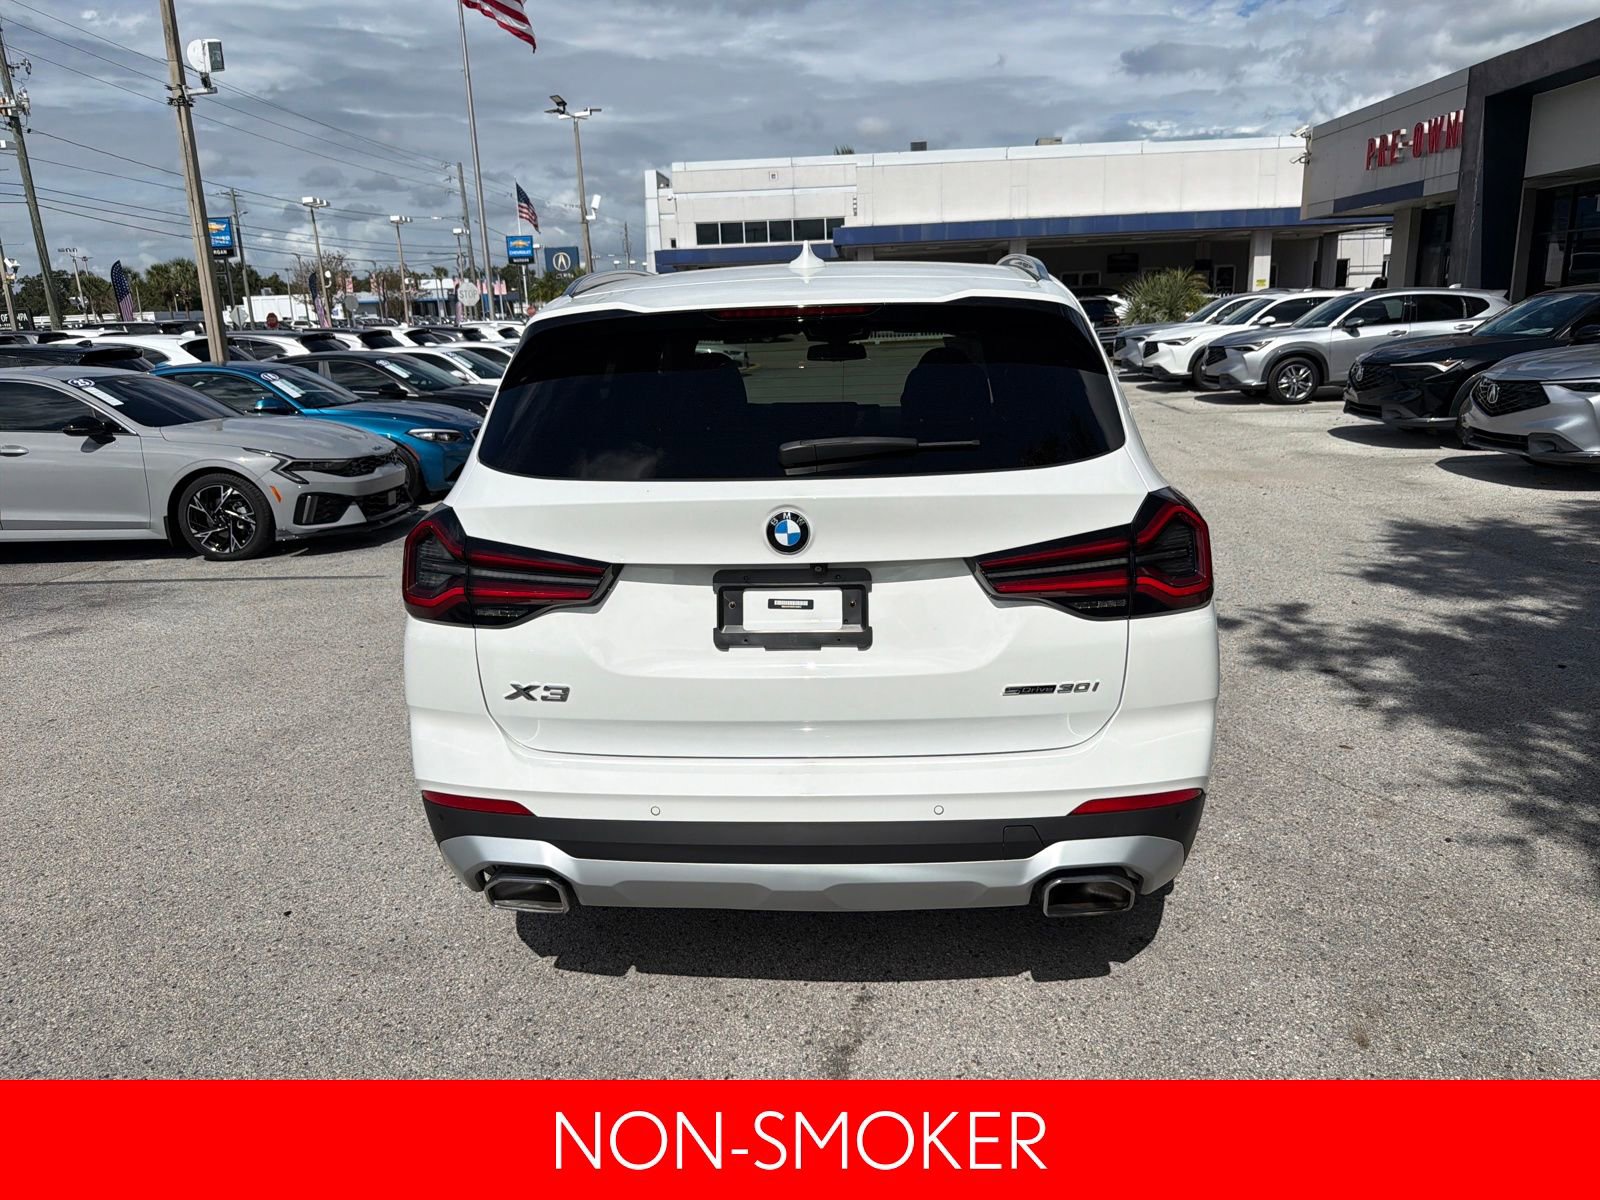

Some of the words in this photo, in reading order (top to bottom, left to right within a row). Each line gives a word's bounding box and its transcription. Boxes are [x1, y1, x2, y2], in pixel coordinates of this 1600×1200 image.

[459, 290, 477, 299] STOP
[770, 511, 805, 526] BMW
[504, 683, 570, 702] X3
